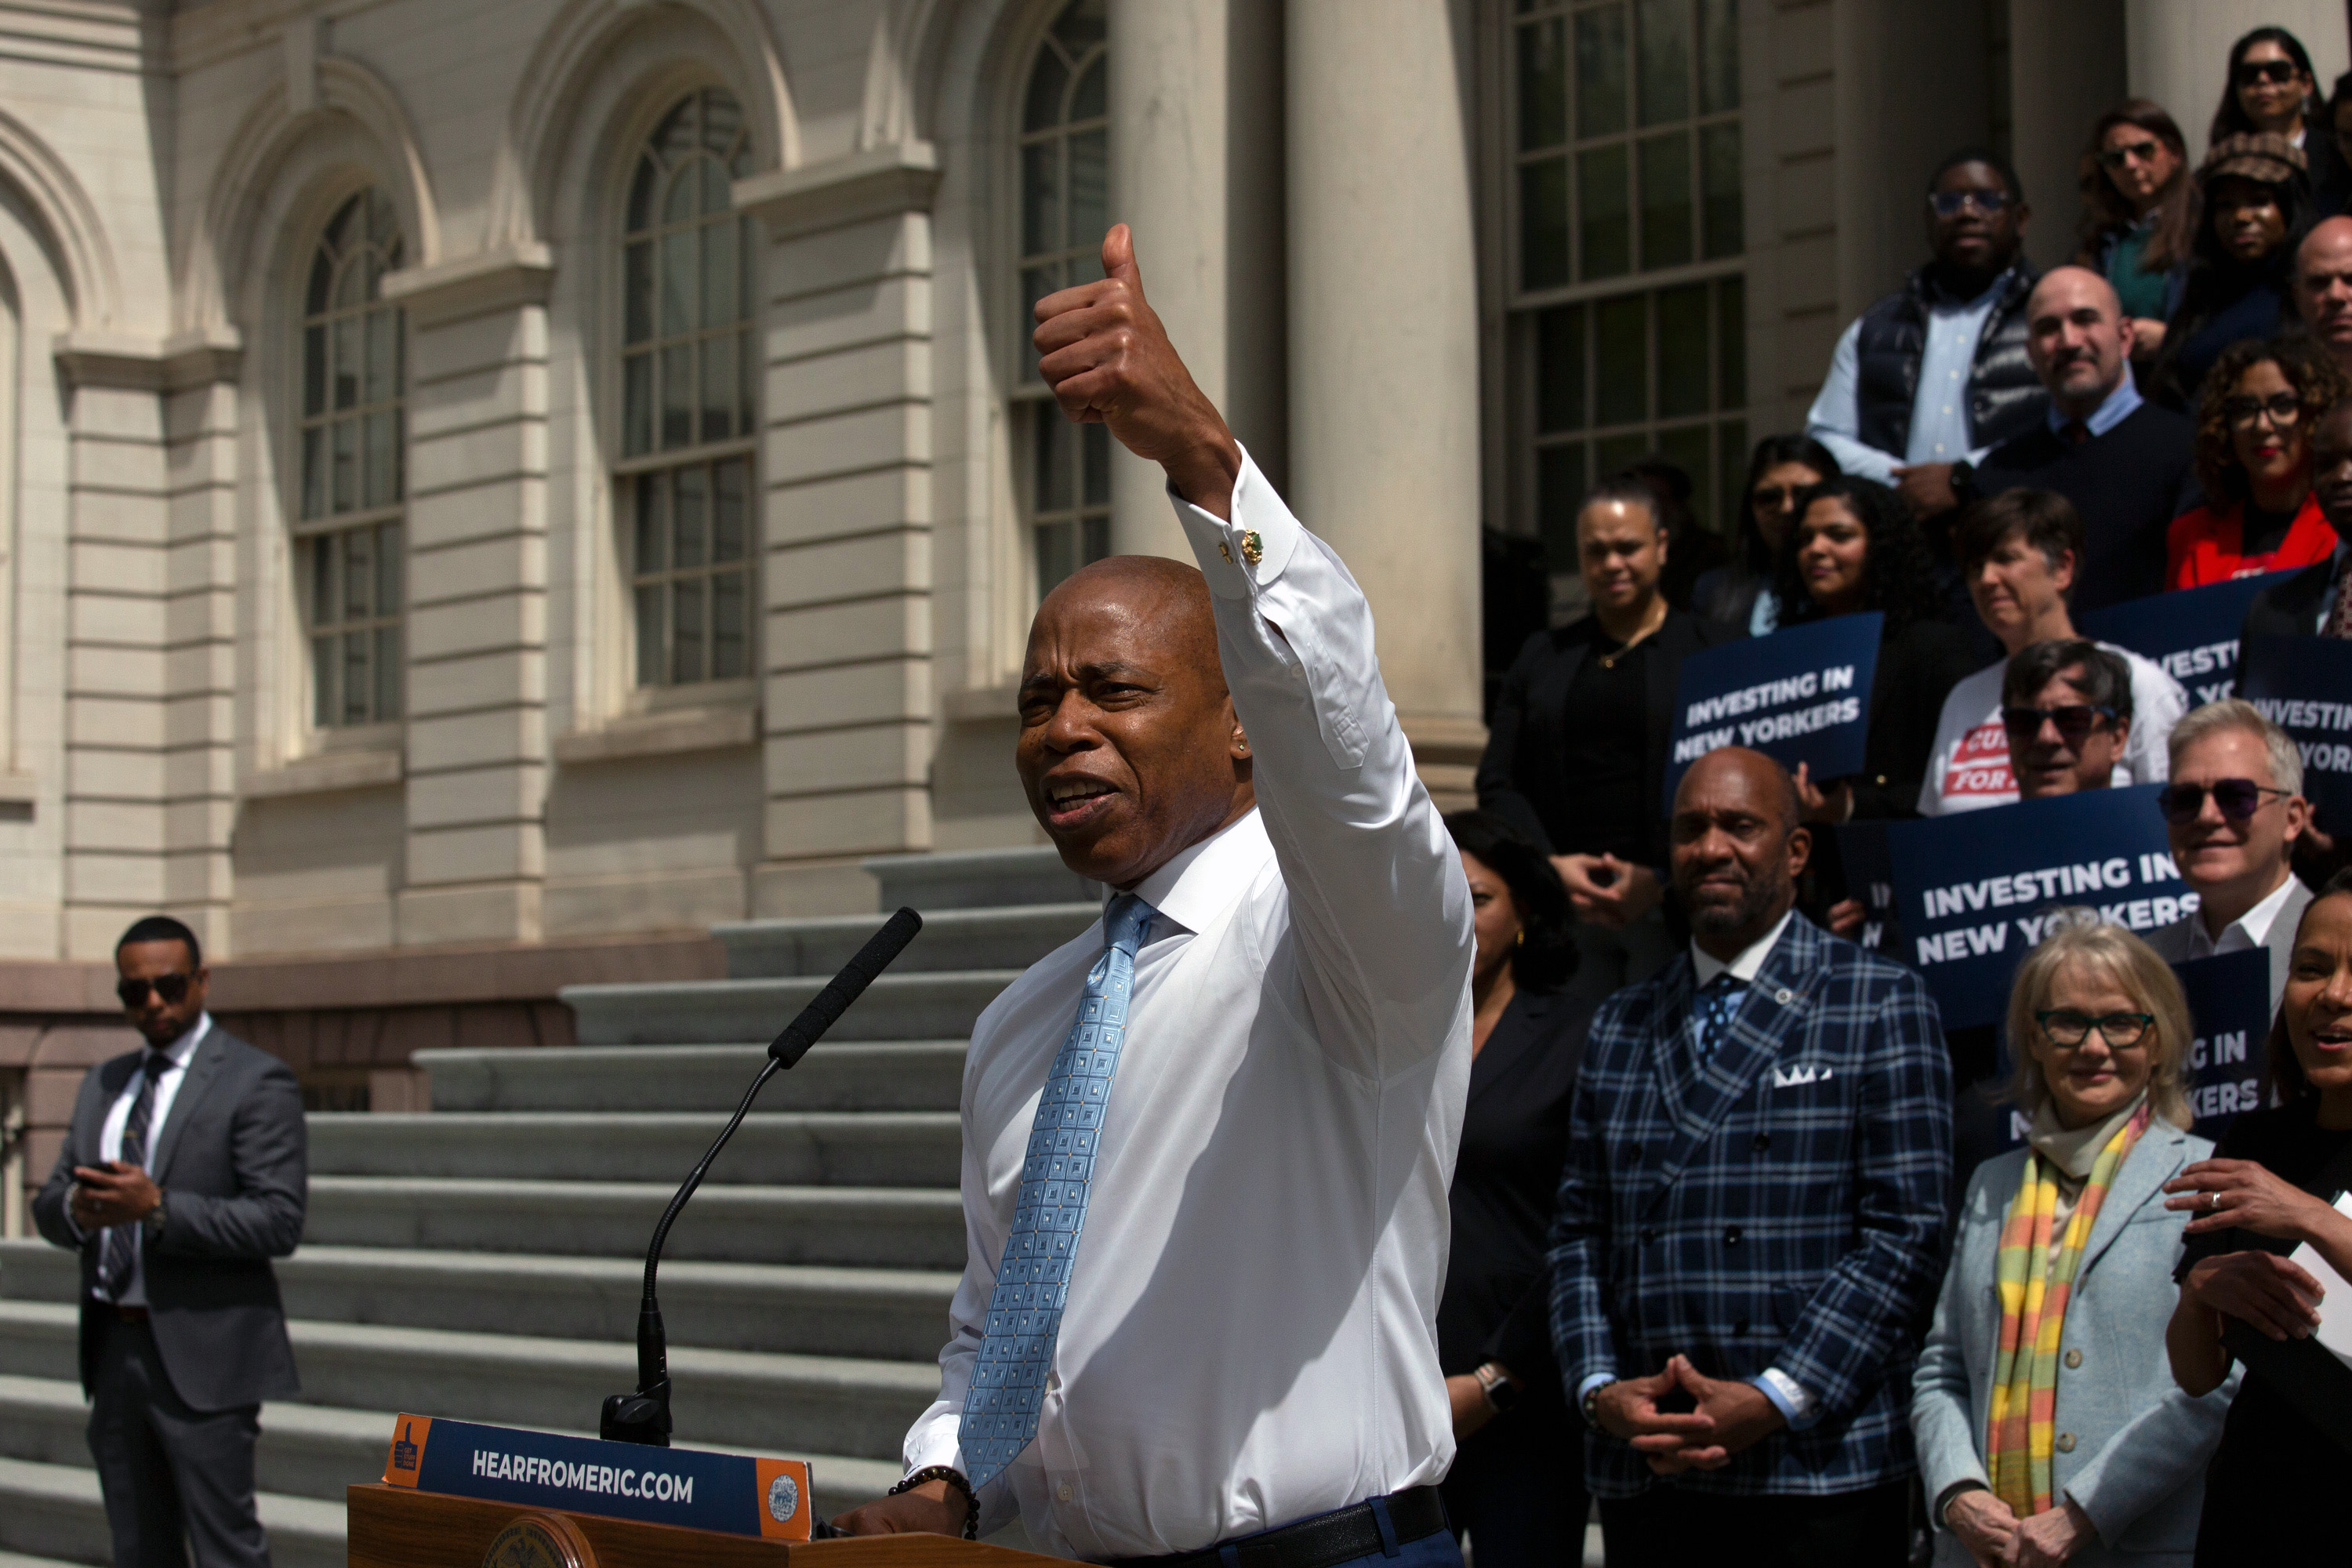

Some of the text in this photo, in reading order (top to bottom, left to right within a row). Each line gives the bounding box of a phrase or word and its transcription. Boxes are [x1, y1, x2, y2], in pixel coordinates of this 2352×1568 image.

[1686, 664, 1855, 728] INVESTING IN
[1673, 696, 1860, 764] NEW YORKERS
[1952, 769, 2006, 790] FOR
[1923, 851, 2183, 920] INVESTING IN
[1917, 920, 2009, 965] NEW
[2214, 1029, 2246, 1066] IN
[472, 1450, 694, 1504] HEARFROMERIC.COM
